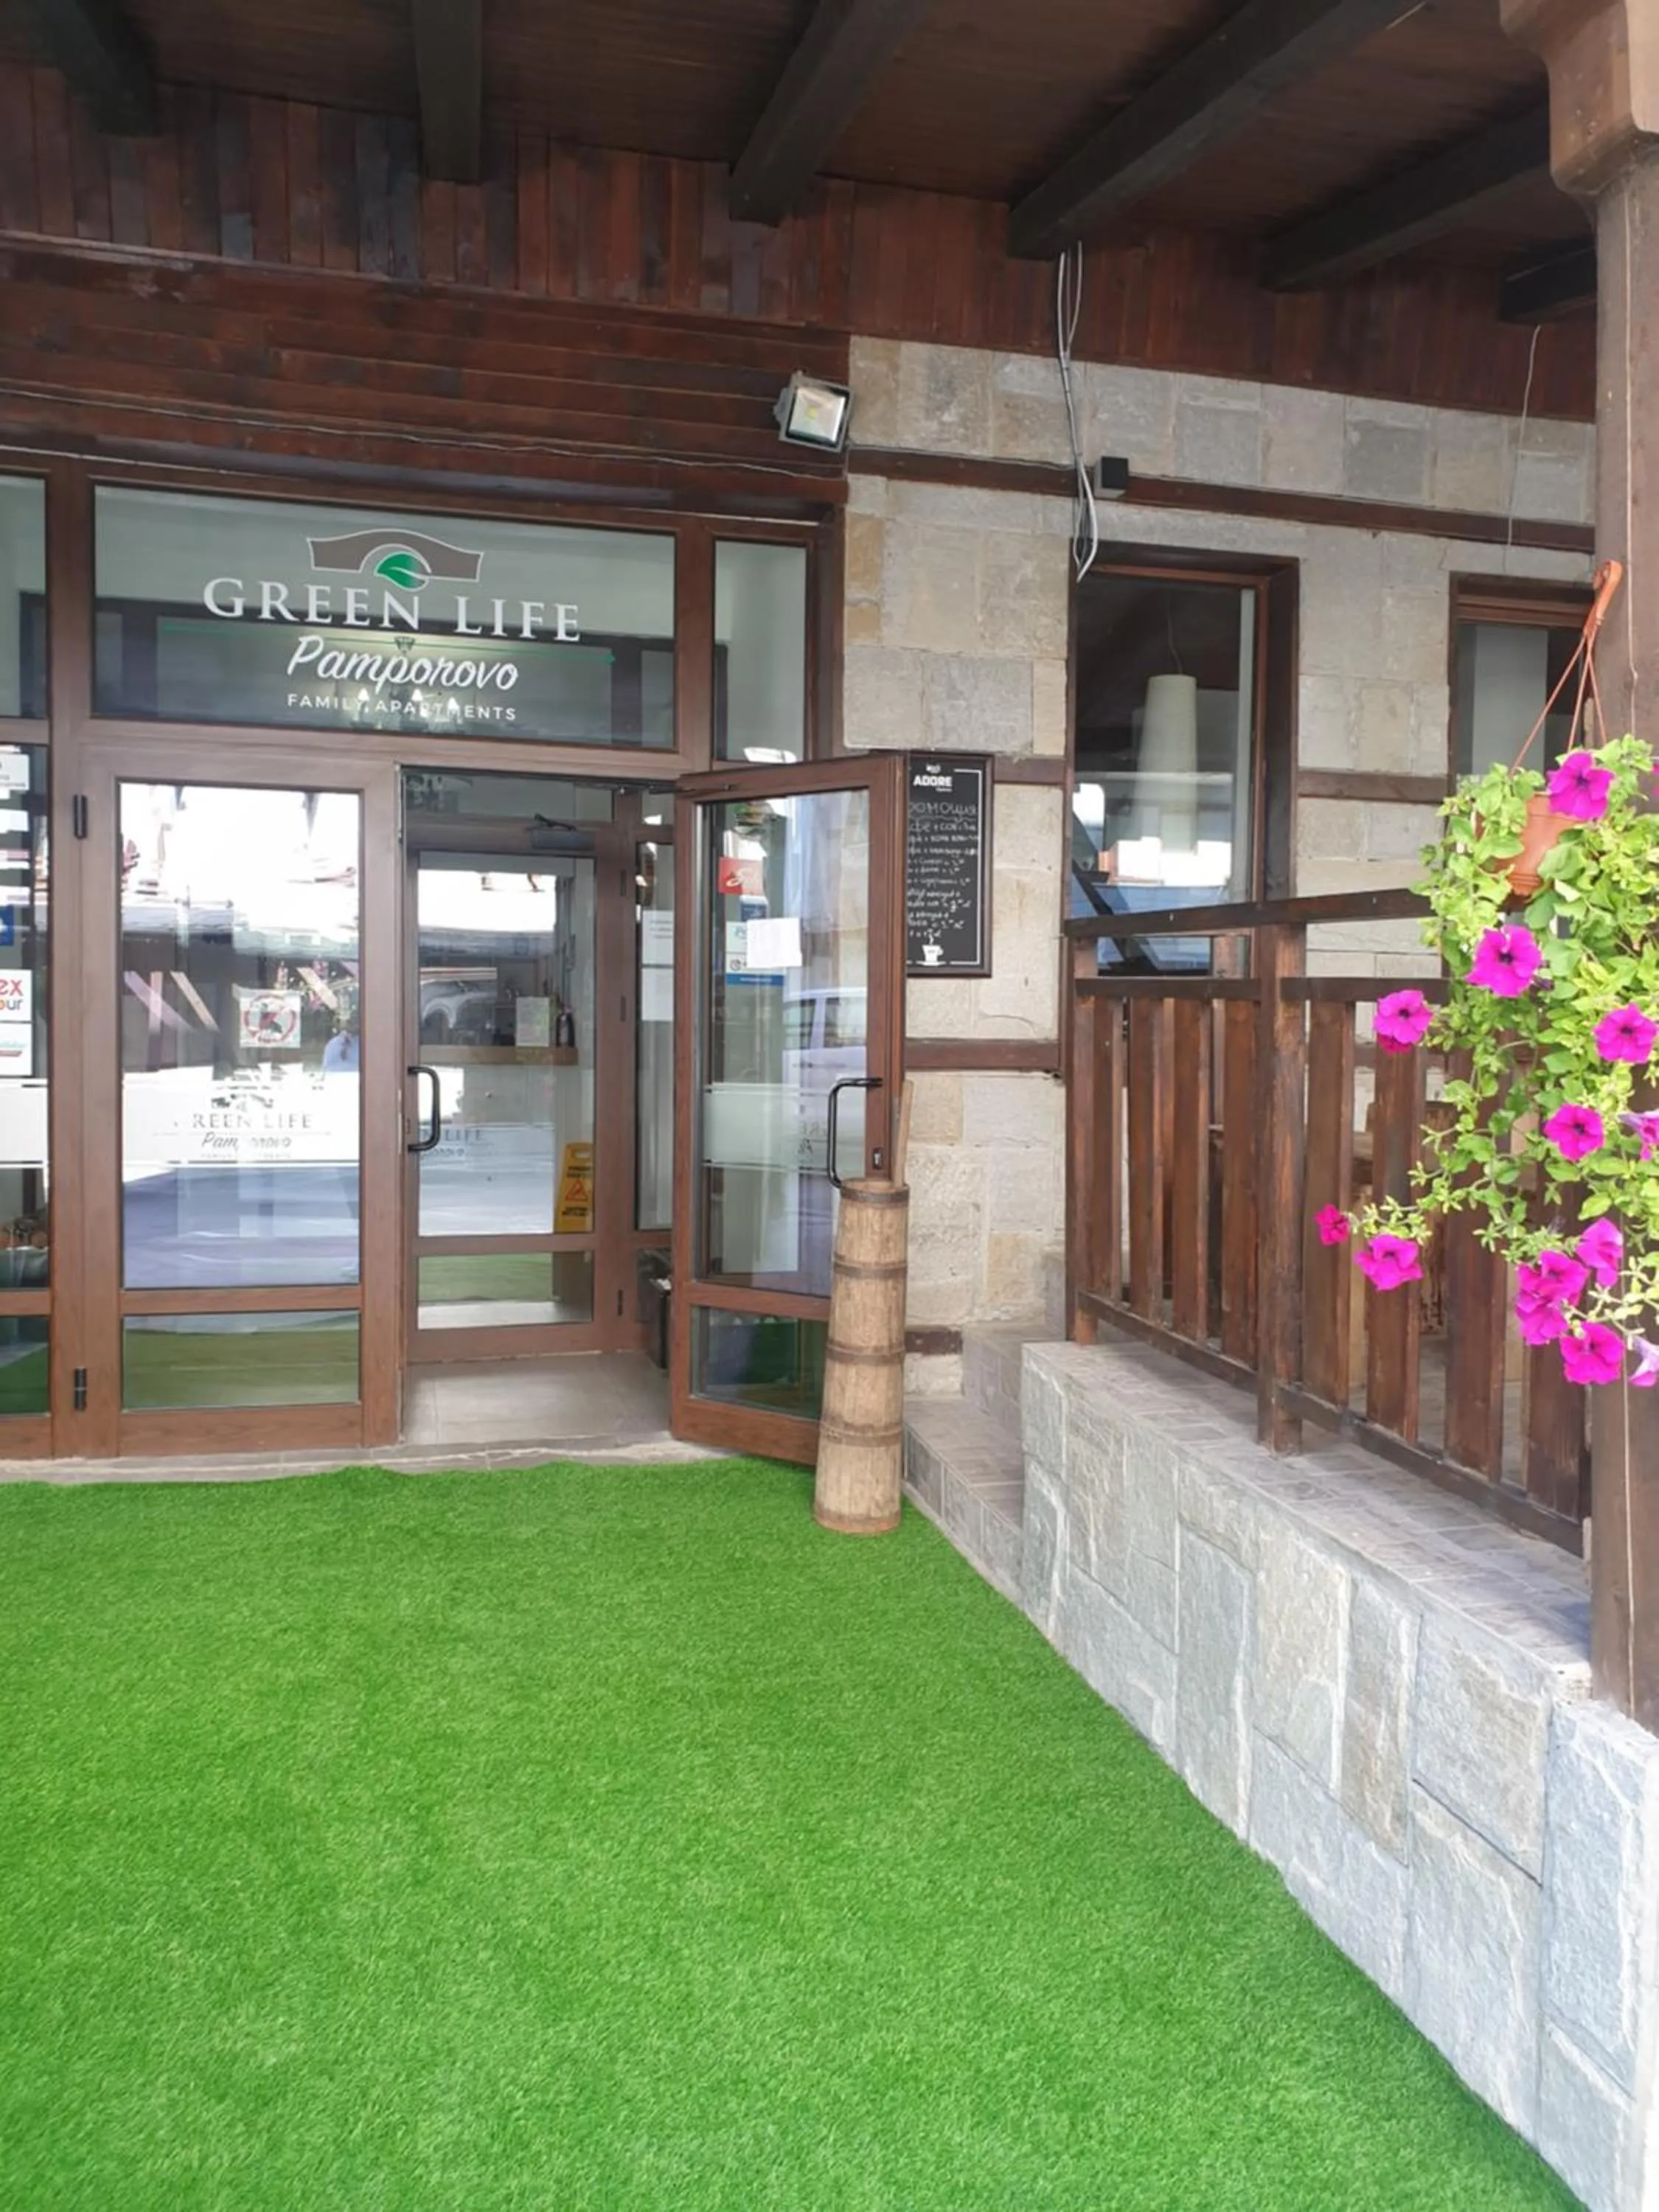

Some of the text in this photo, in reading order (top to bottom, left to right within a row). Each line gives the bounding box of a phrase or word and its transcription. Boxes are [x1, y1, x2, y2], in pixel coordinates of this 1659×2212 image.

[203, 577, 582, 642] GREEN LIFE
[287, 634, 519, 694] Pamporovo
[287, 693, 516, 720] FAMILY APARTMENTS
[914, 775, 952, 787] ADORE
[184, 1113, 251, 1129] REEN
